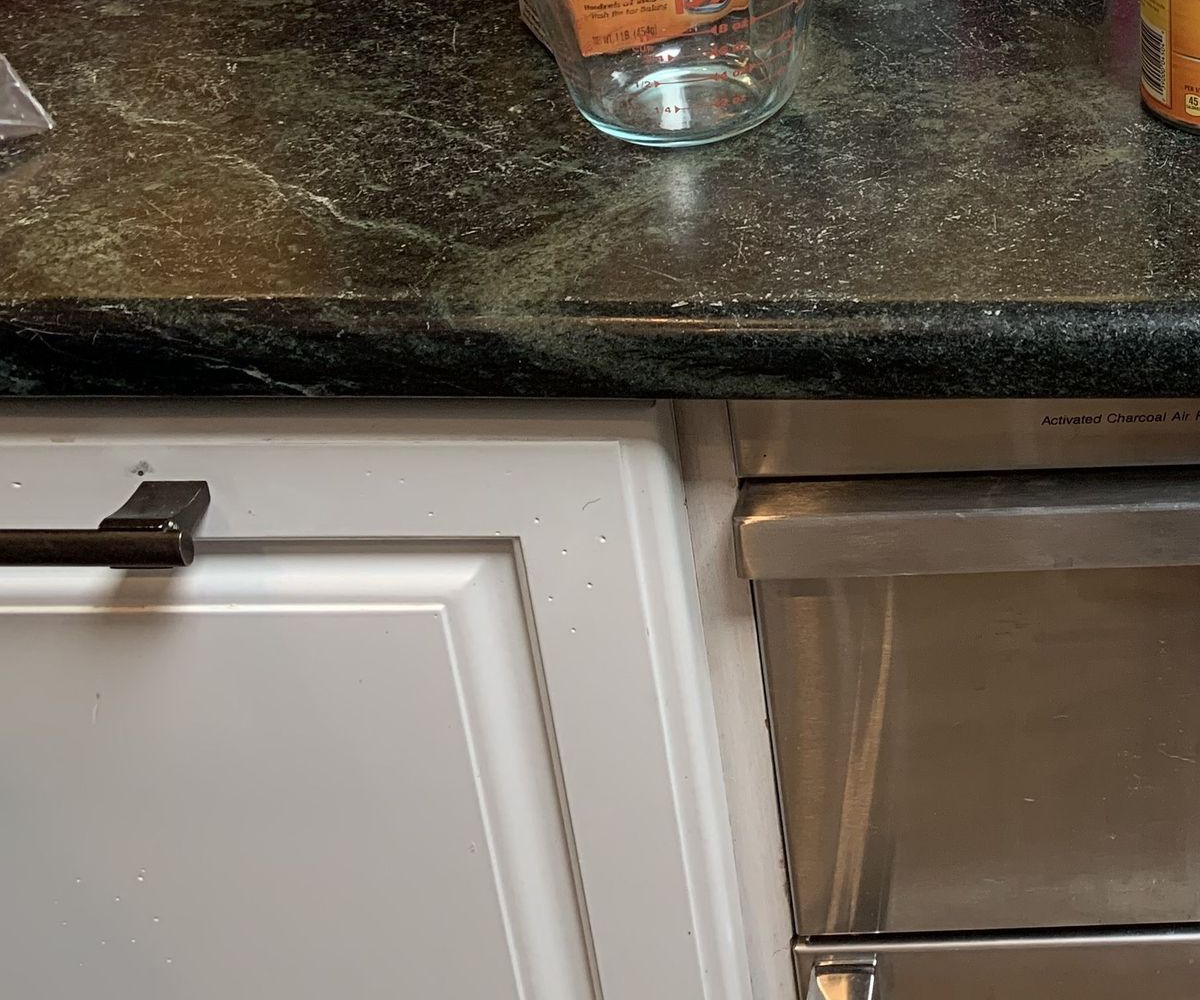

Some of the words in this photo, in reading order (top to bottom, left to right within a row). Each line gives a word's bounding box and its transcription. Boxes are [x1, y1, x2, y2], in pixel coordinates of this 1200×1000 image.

[1188, 96, 1199, 106] 45
[1041, 413, 1103, 426] Activated
[1106, 411, 1168, 424] Charcoal
[1171, 411, 1191, 422] Air
